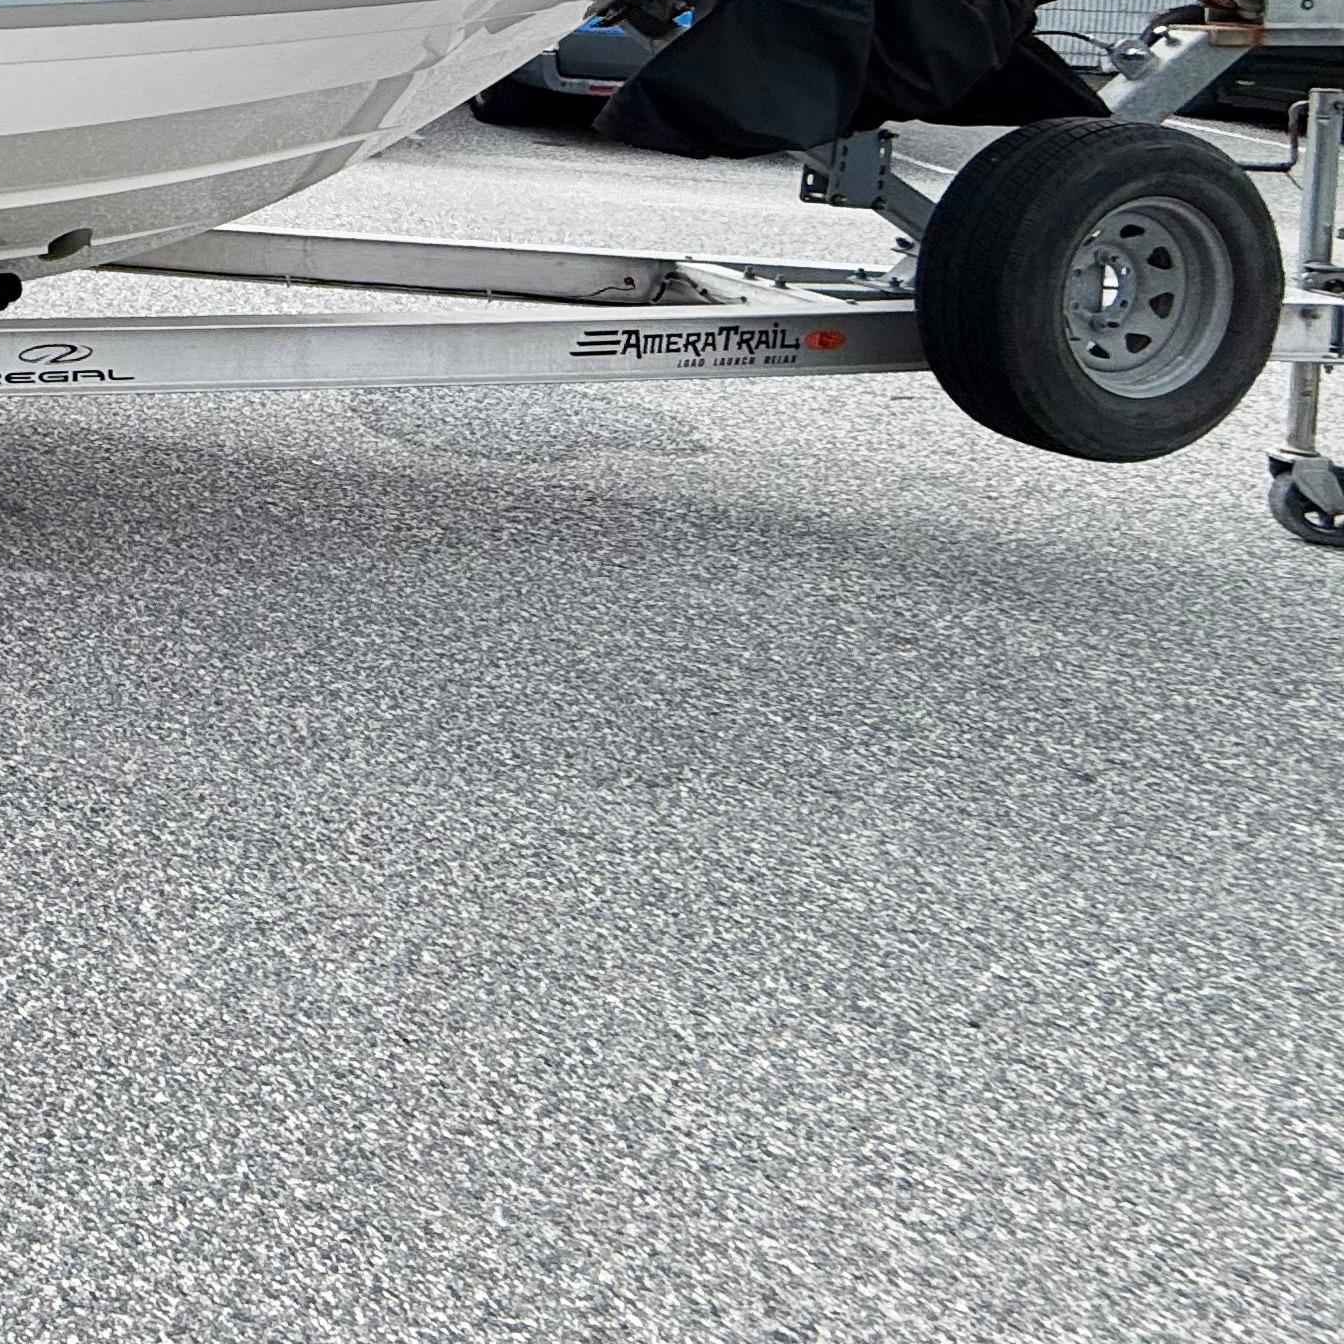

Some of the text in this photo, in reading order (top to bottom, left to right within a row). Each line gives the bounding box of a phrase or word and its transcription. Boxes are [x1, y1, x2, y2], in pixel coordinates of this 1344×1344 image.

[676, 355, 798, 368] LOAD LAUNCH RELAX
